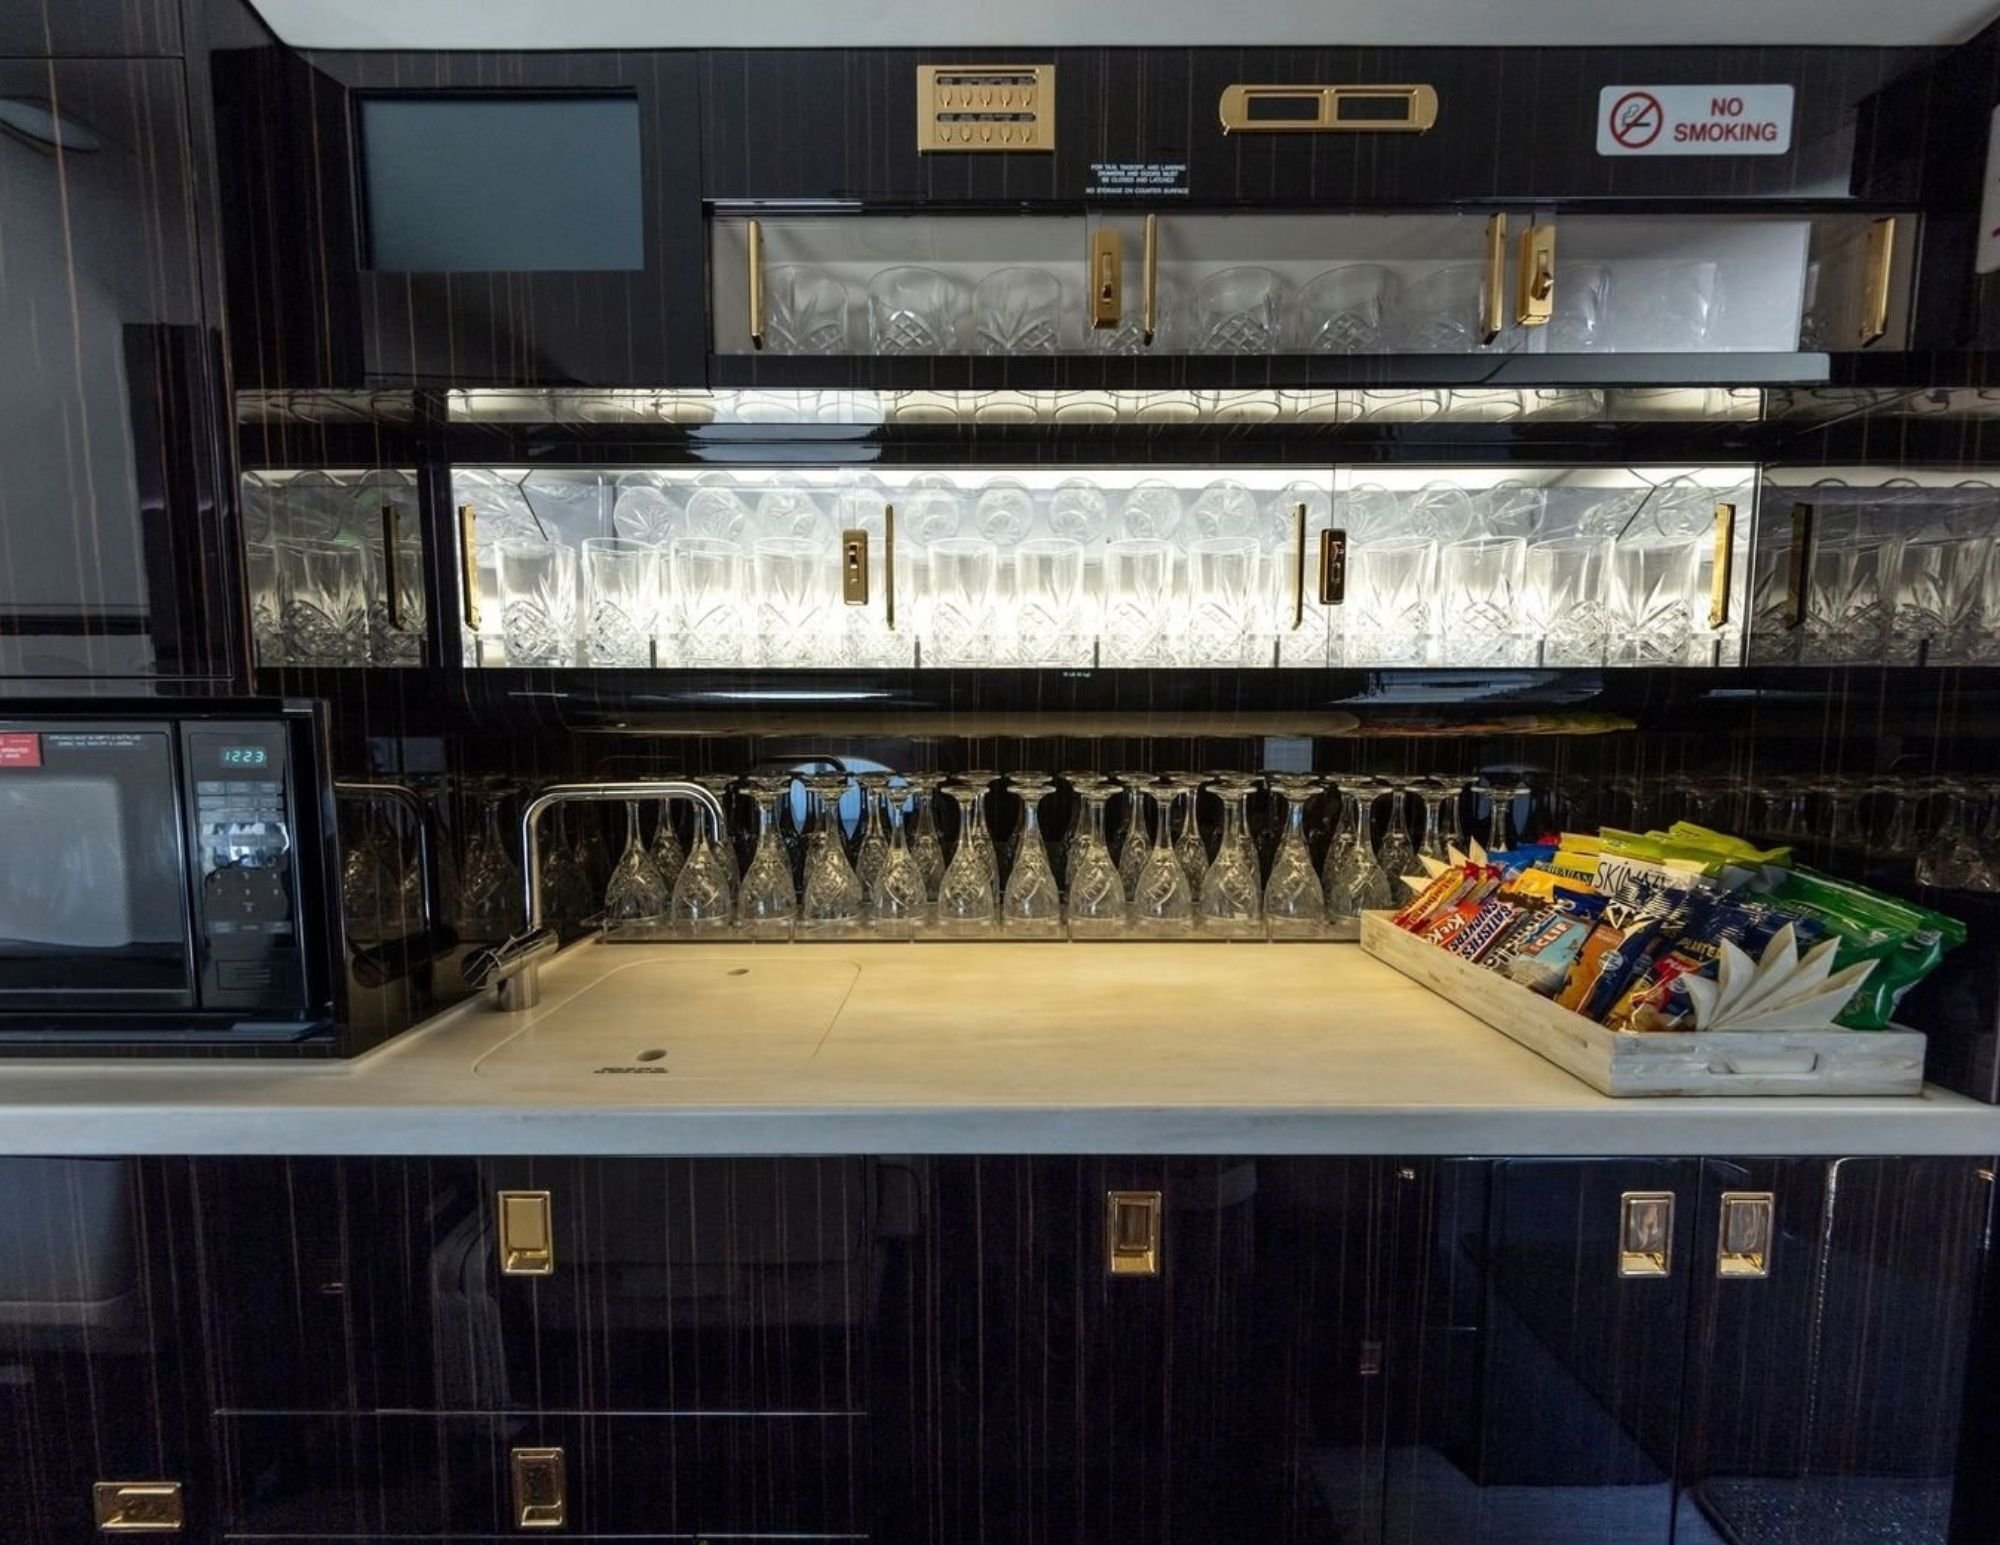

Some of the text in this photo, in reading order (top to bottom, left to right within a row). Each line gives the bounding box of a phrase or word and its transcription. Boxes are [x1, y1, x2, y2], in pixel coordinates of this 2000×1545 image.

[1711, 97, 1743, 116] NO
[1674, 123, 1777, 142] SMOKING
[1461, 905, 1513, 960] SATISFIES
